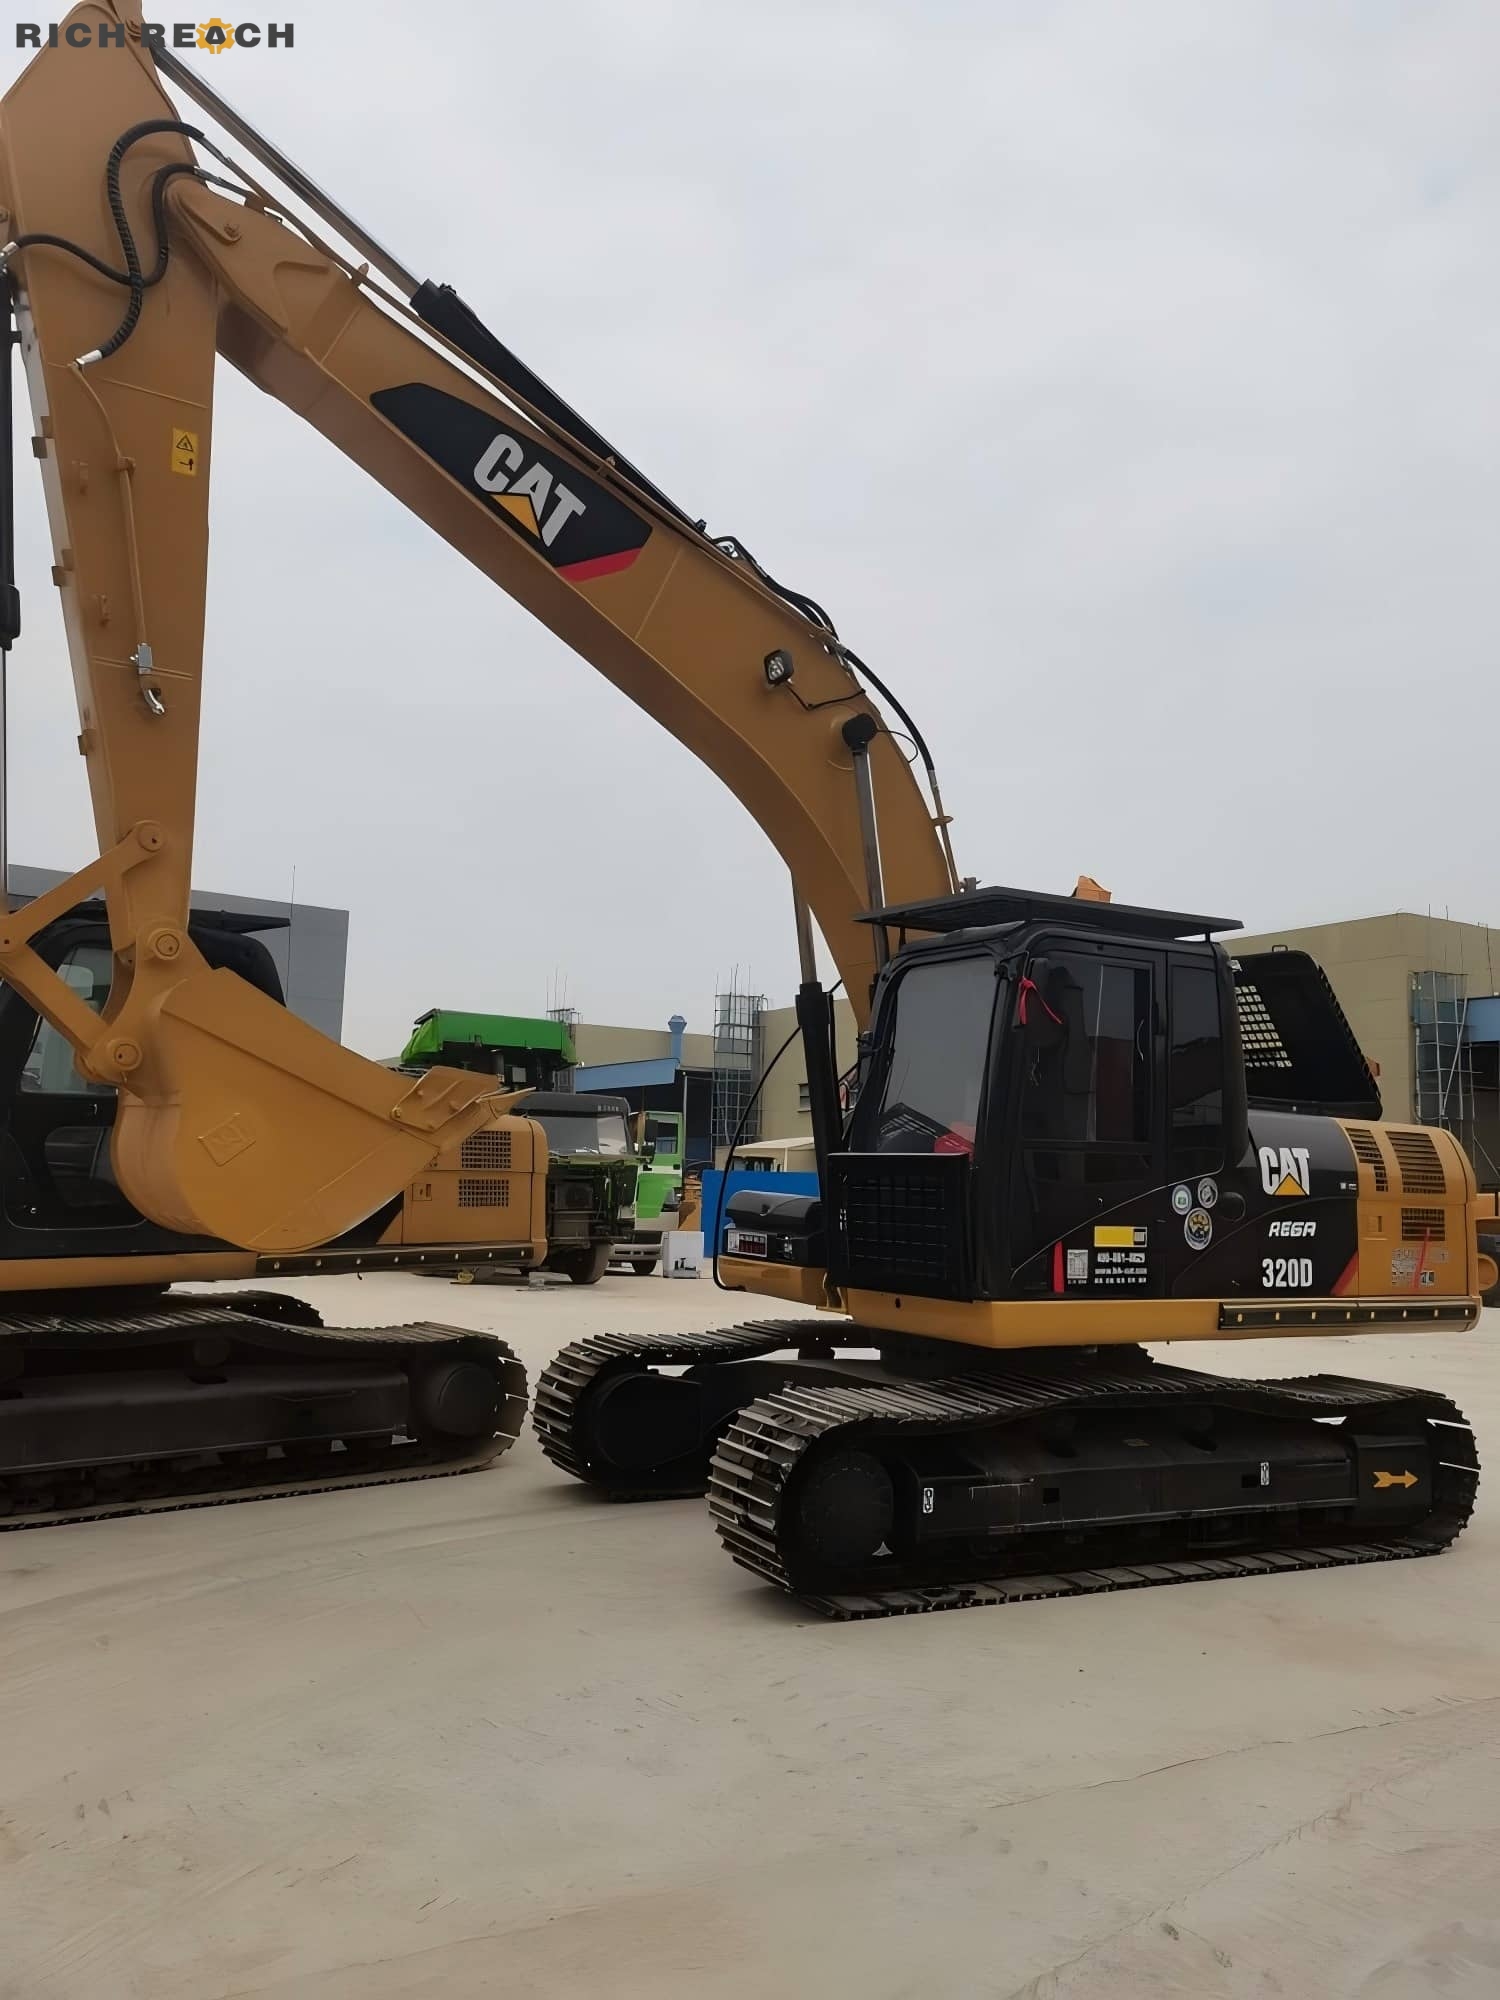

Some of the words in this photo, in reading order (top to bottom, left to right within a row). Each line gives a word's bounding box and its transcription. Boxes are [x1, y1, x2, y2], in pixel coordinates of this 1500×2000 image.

[473, 433, 587, 547] CAT
[1258, 1146, 1310, 1196] CAT
[1262, 1257, 1313, 1288] 320D
